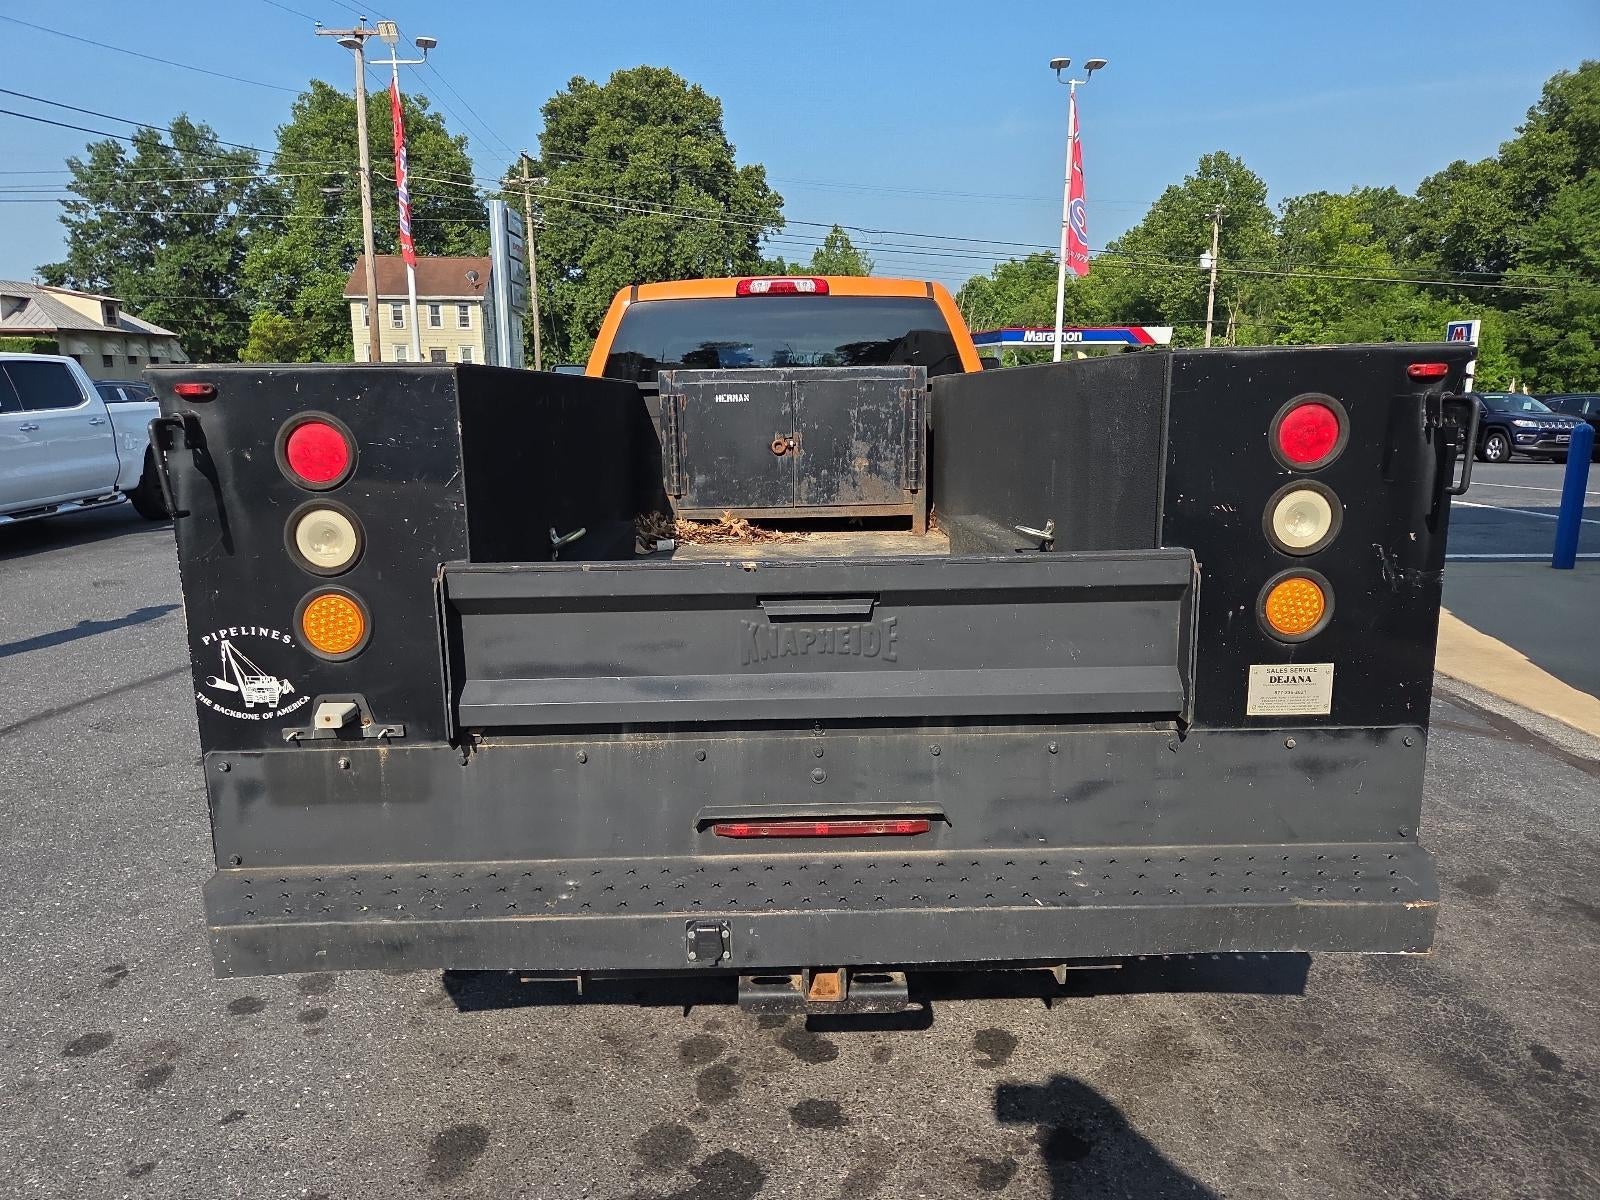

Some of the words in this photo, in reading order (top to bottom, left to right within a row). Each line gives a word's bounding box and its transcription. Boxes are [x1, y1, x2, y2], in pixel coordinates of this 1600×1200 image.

[1023, 330, 1083, 342] Marahon
[715, 393, 750, 403] HERMAN
[740, 616, 898, 666] KNAPHEIDE
[1269, 675, 1312, 684] DEJANA
[196, 691, 212, 707] THE
[213, 703, 261, 720] BACKBONE
[262, 711, 274, 720] OF
[276, 695, 311, 717] AMERICA
